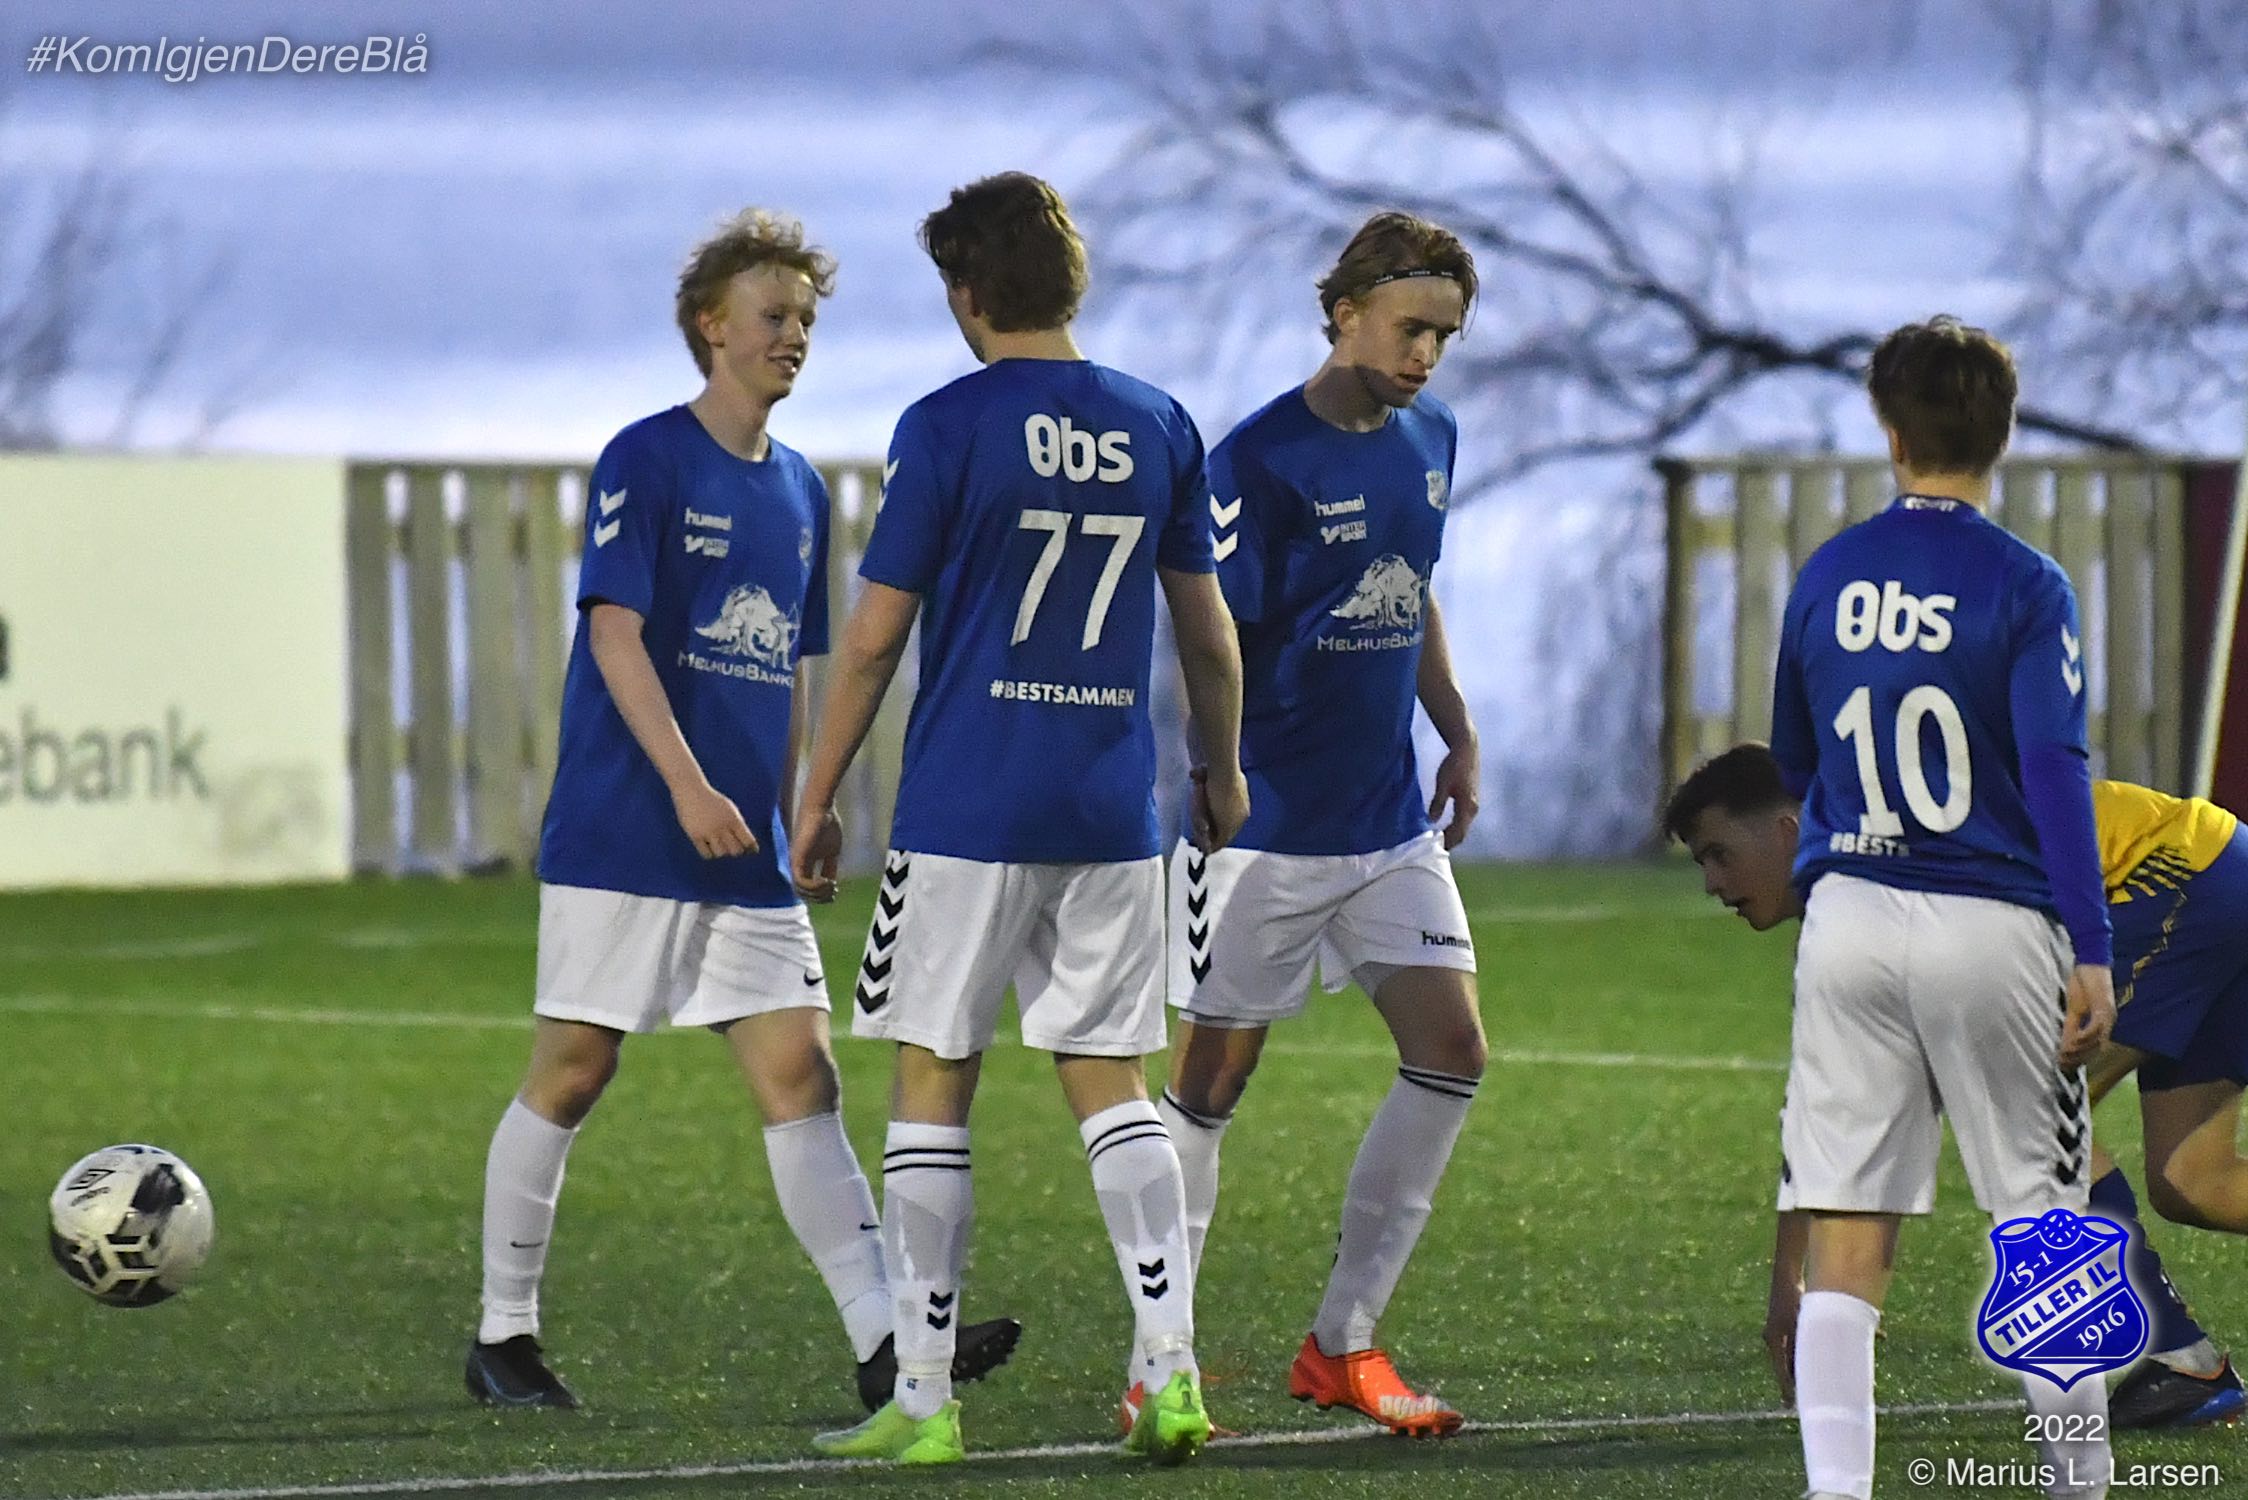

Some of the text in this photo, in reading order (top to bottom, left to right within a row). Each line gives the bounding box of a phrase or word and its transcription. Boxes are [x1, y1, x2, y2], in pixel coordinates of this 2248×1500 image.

[1010, 509, 1146, 650] 77
[990, 679, 1135, 707] #BESTSAMMEN
[1833, 685, 1972, 837] 10
